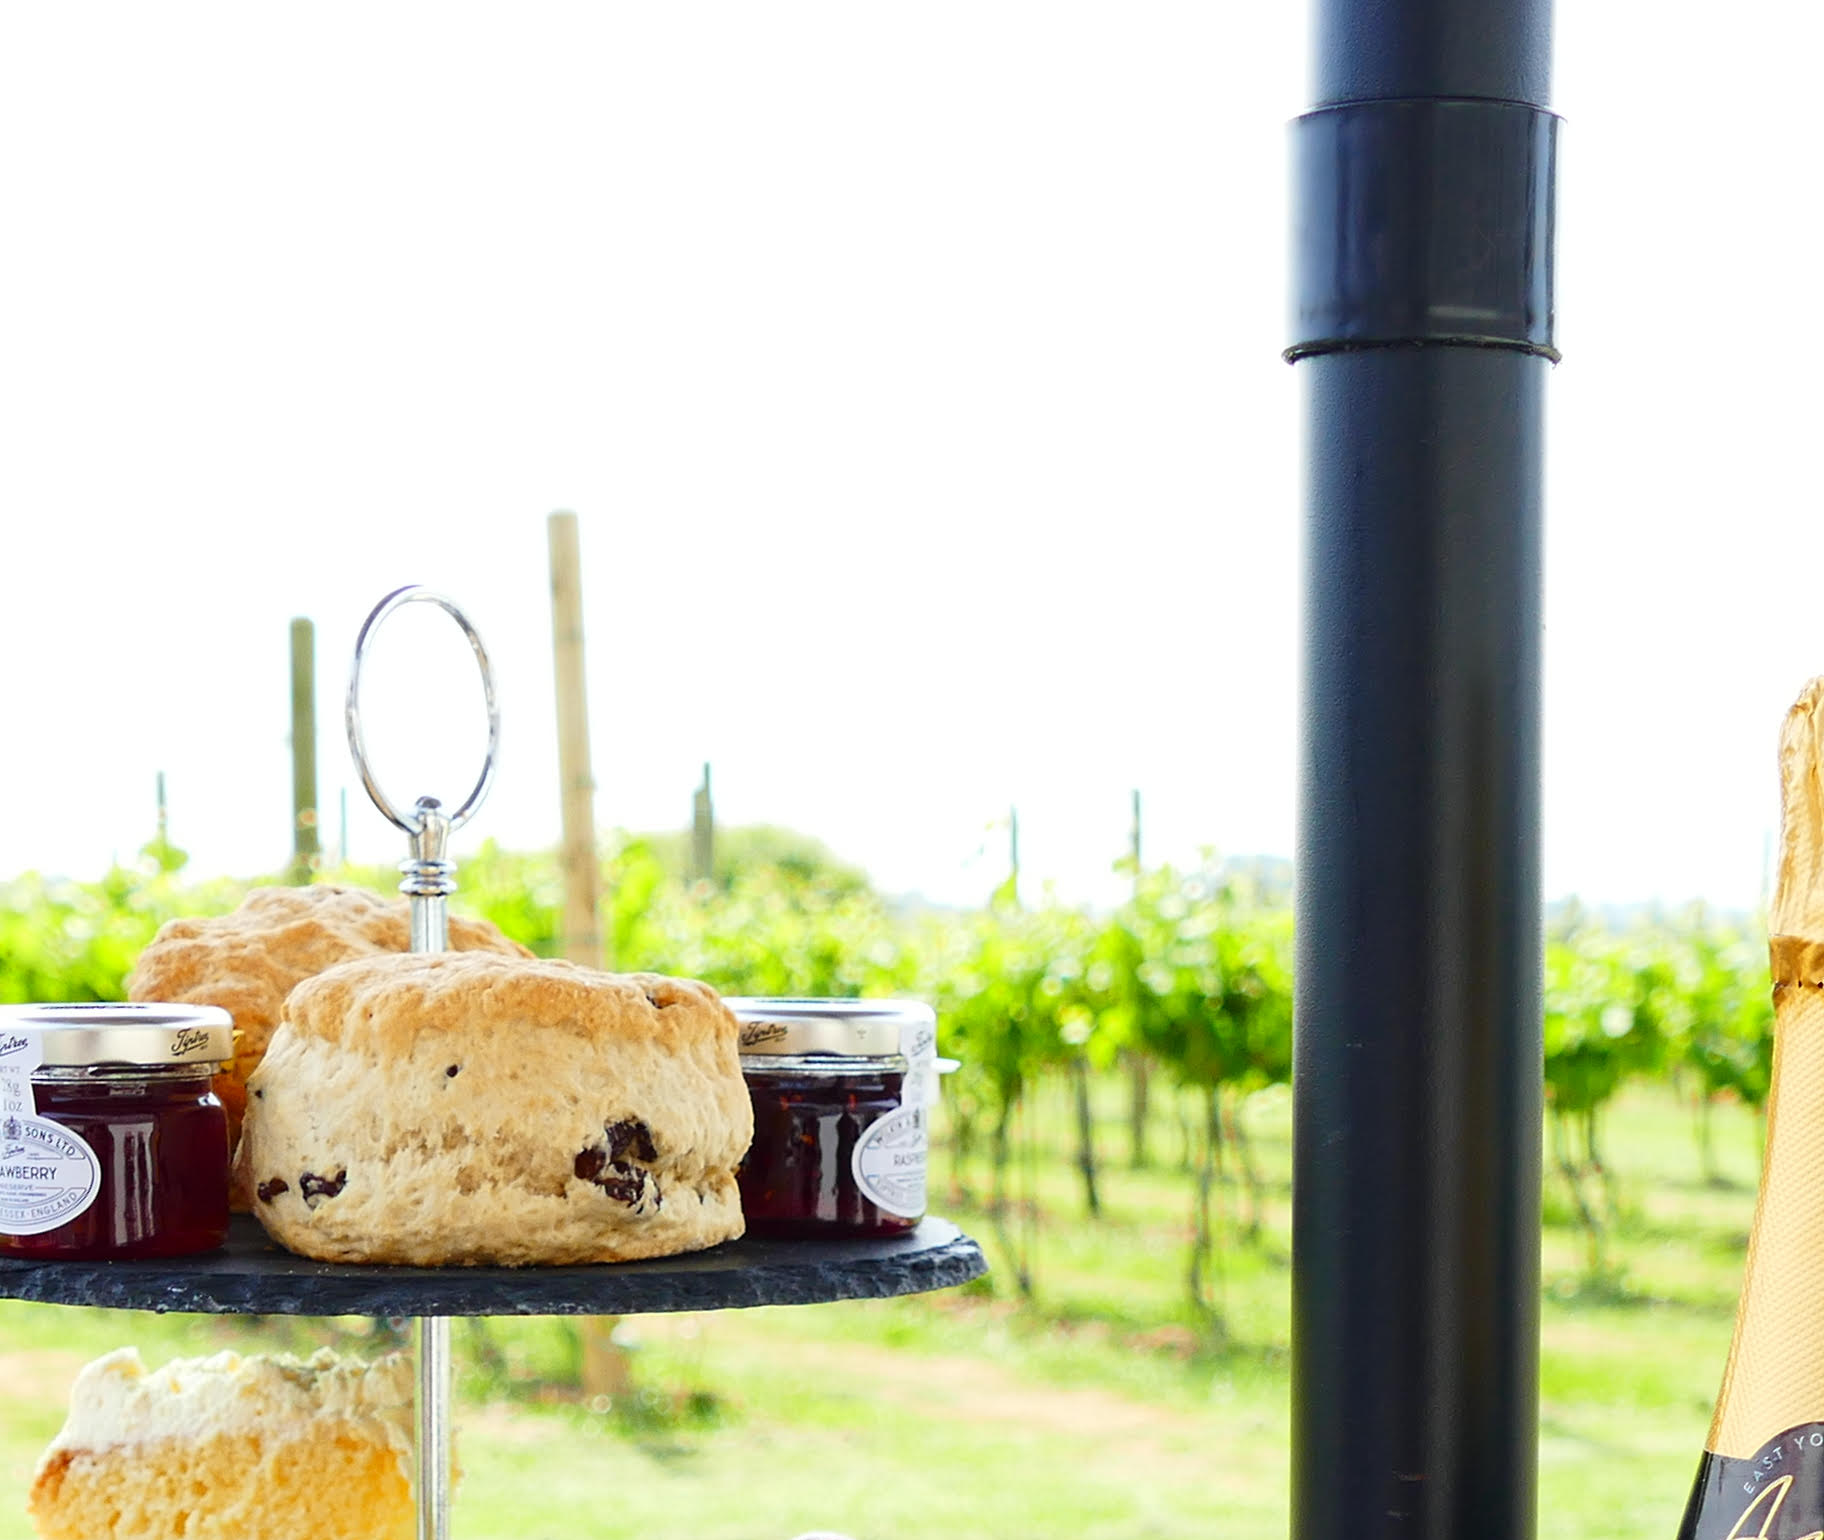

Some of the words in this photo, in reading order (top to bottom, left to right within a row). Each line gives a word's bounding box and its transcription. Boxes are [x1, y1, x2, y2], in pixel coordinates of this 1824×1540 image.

[25, 1126, 54, 1144] SONS
[55, 1138, 76, 1157] LTD
[1743, 1446, 1785, 1496] EAST
